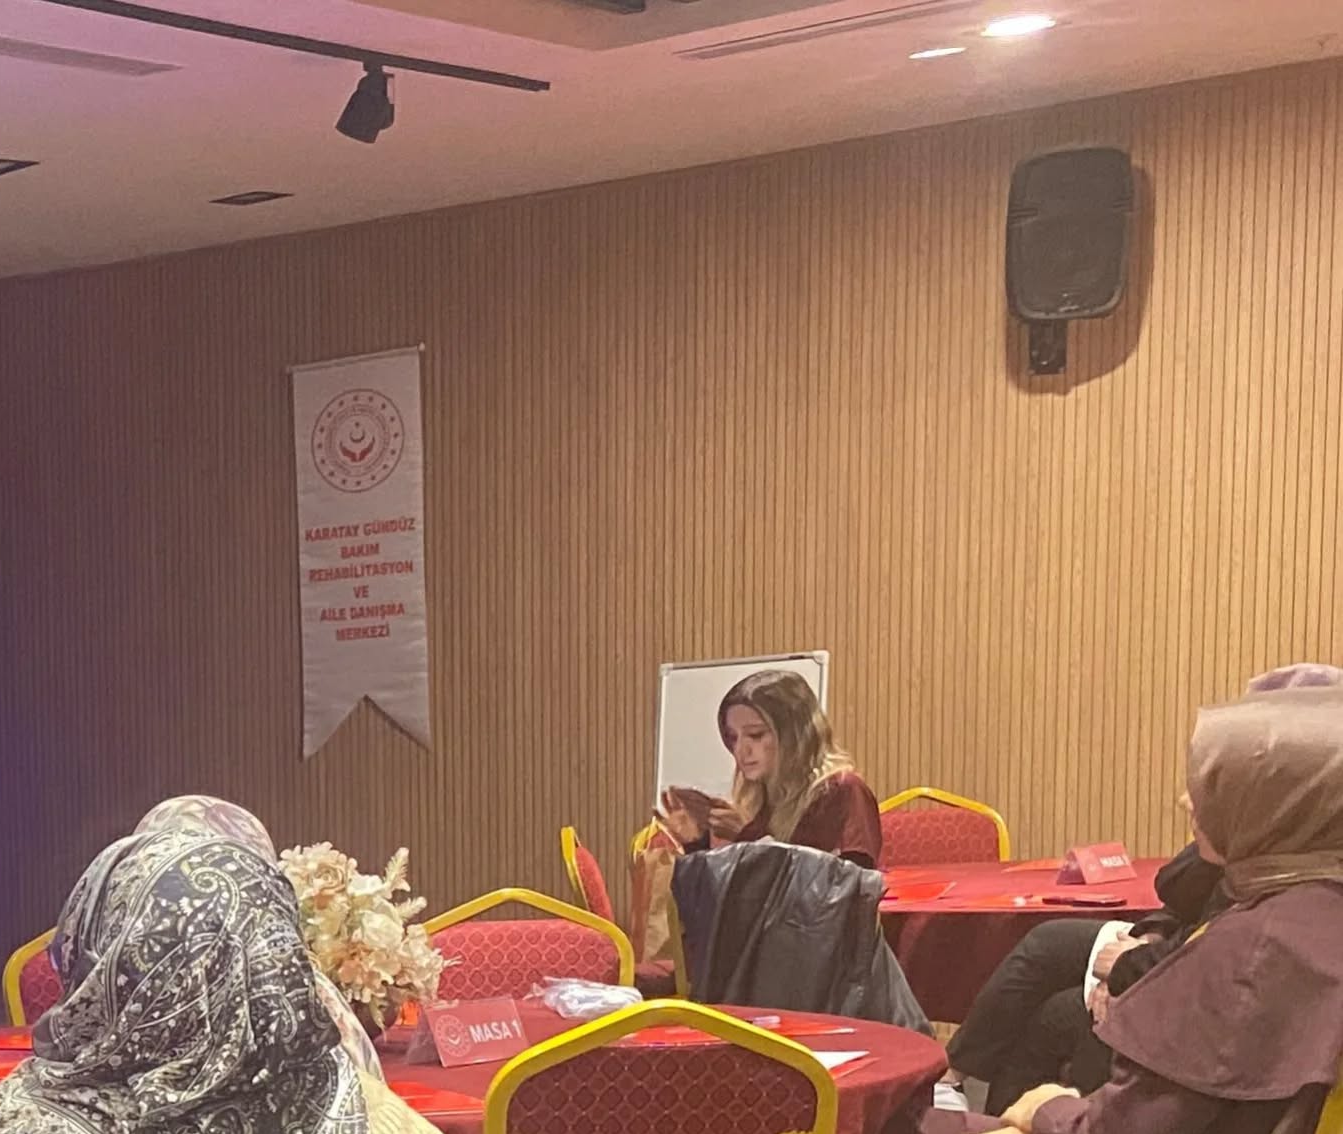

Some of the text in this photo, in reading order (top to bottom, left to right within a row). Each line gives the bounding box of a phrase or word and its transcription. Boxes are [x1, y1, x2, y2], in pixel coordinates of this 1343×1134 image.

[304, 516, 416, 541] KARATAY GÜNDÜZ
[340, 543, 380, 559] BAKIM
[353, 585, 369, 598] VE
[350, 602, 405, 620] DANIŞMA
[336, 622, 390, 641] MERKEZİ
[469, 1019, 523, 1043] MASA 1
